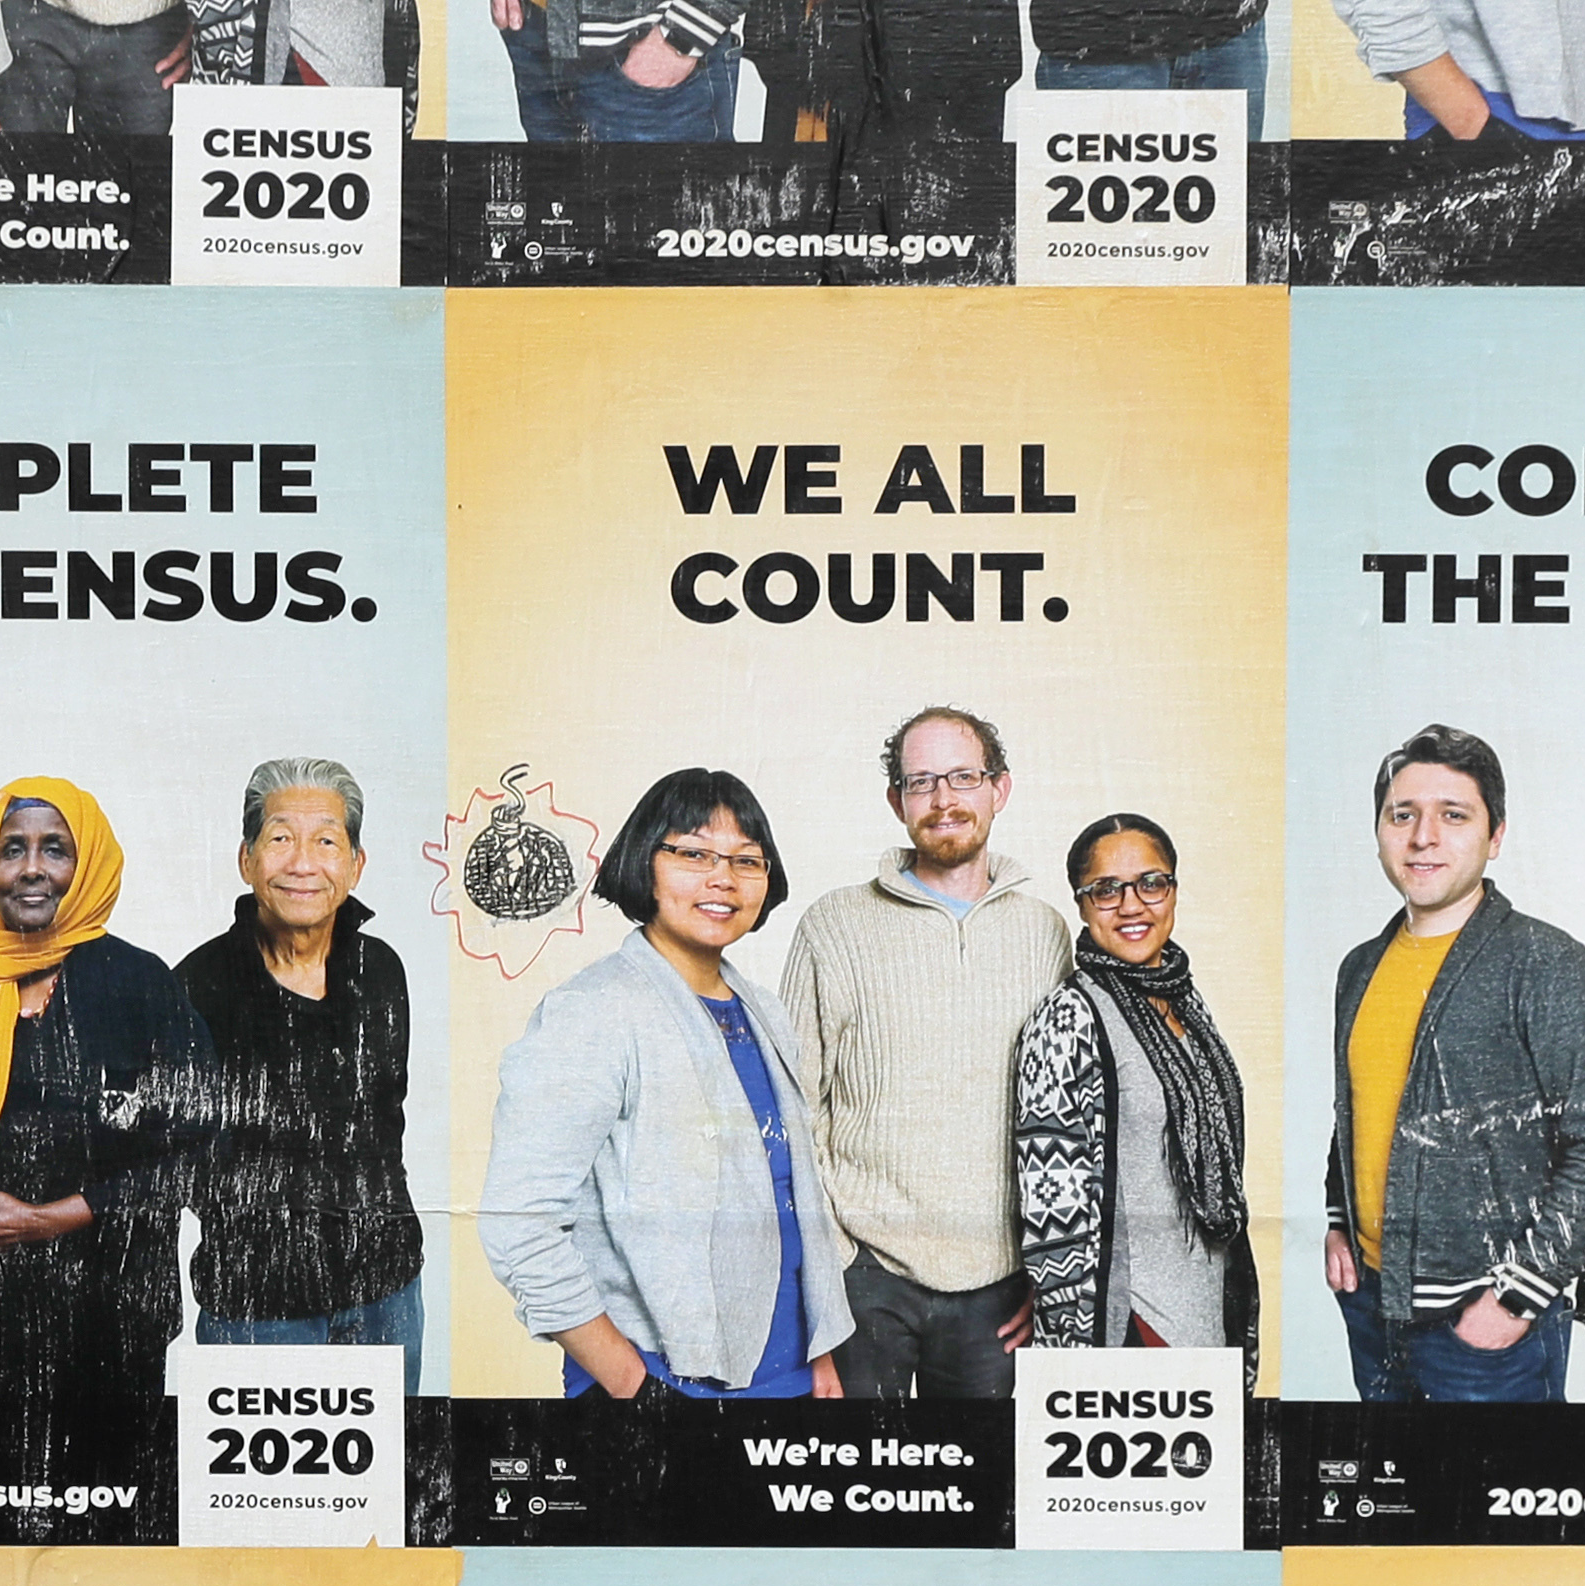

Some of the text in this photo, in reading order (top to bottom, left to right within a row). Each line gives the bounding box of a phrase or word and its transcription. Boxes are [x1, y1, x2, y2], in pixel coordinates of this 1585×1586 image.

[203, 128, 372, 160] CENSUS
[1046, 133, 1218, 163] CENSUS
[26, 172, 131, 205] Here.
[201, 170, 370, 221] 2020
[1045, 175, 1216, 224] 2020
[0, 219, 131, 251] Count.
[203, 237, 364, 259] 2020census.gov
[656, 227, 976, 265] 2020census.gov
[1047, 242, 1210, 262] 2020census.gov
[662, 444, 1077, 515] WE ALL
[670, 551, 1069, 625] COUNT.
[1362, 553, 1570, 624] THE
[207, 1387, 375, 1416] CENSUS
[1045, 1390, 1214, 1419] CENSUS
[207, 1427, 374, 1476] 2020
[742, 1436, 975, 1467] We're Here.
[1044, 1431, 1213, 1479] 2020
[209, 1493, 368, 1513] 2020census.gov
[768, 1484, 975, 1513] We Count.
[1046, 1497, 1207, 1516] 2020census.gov
